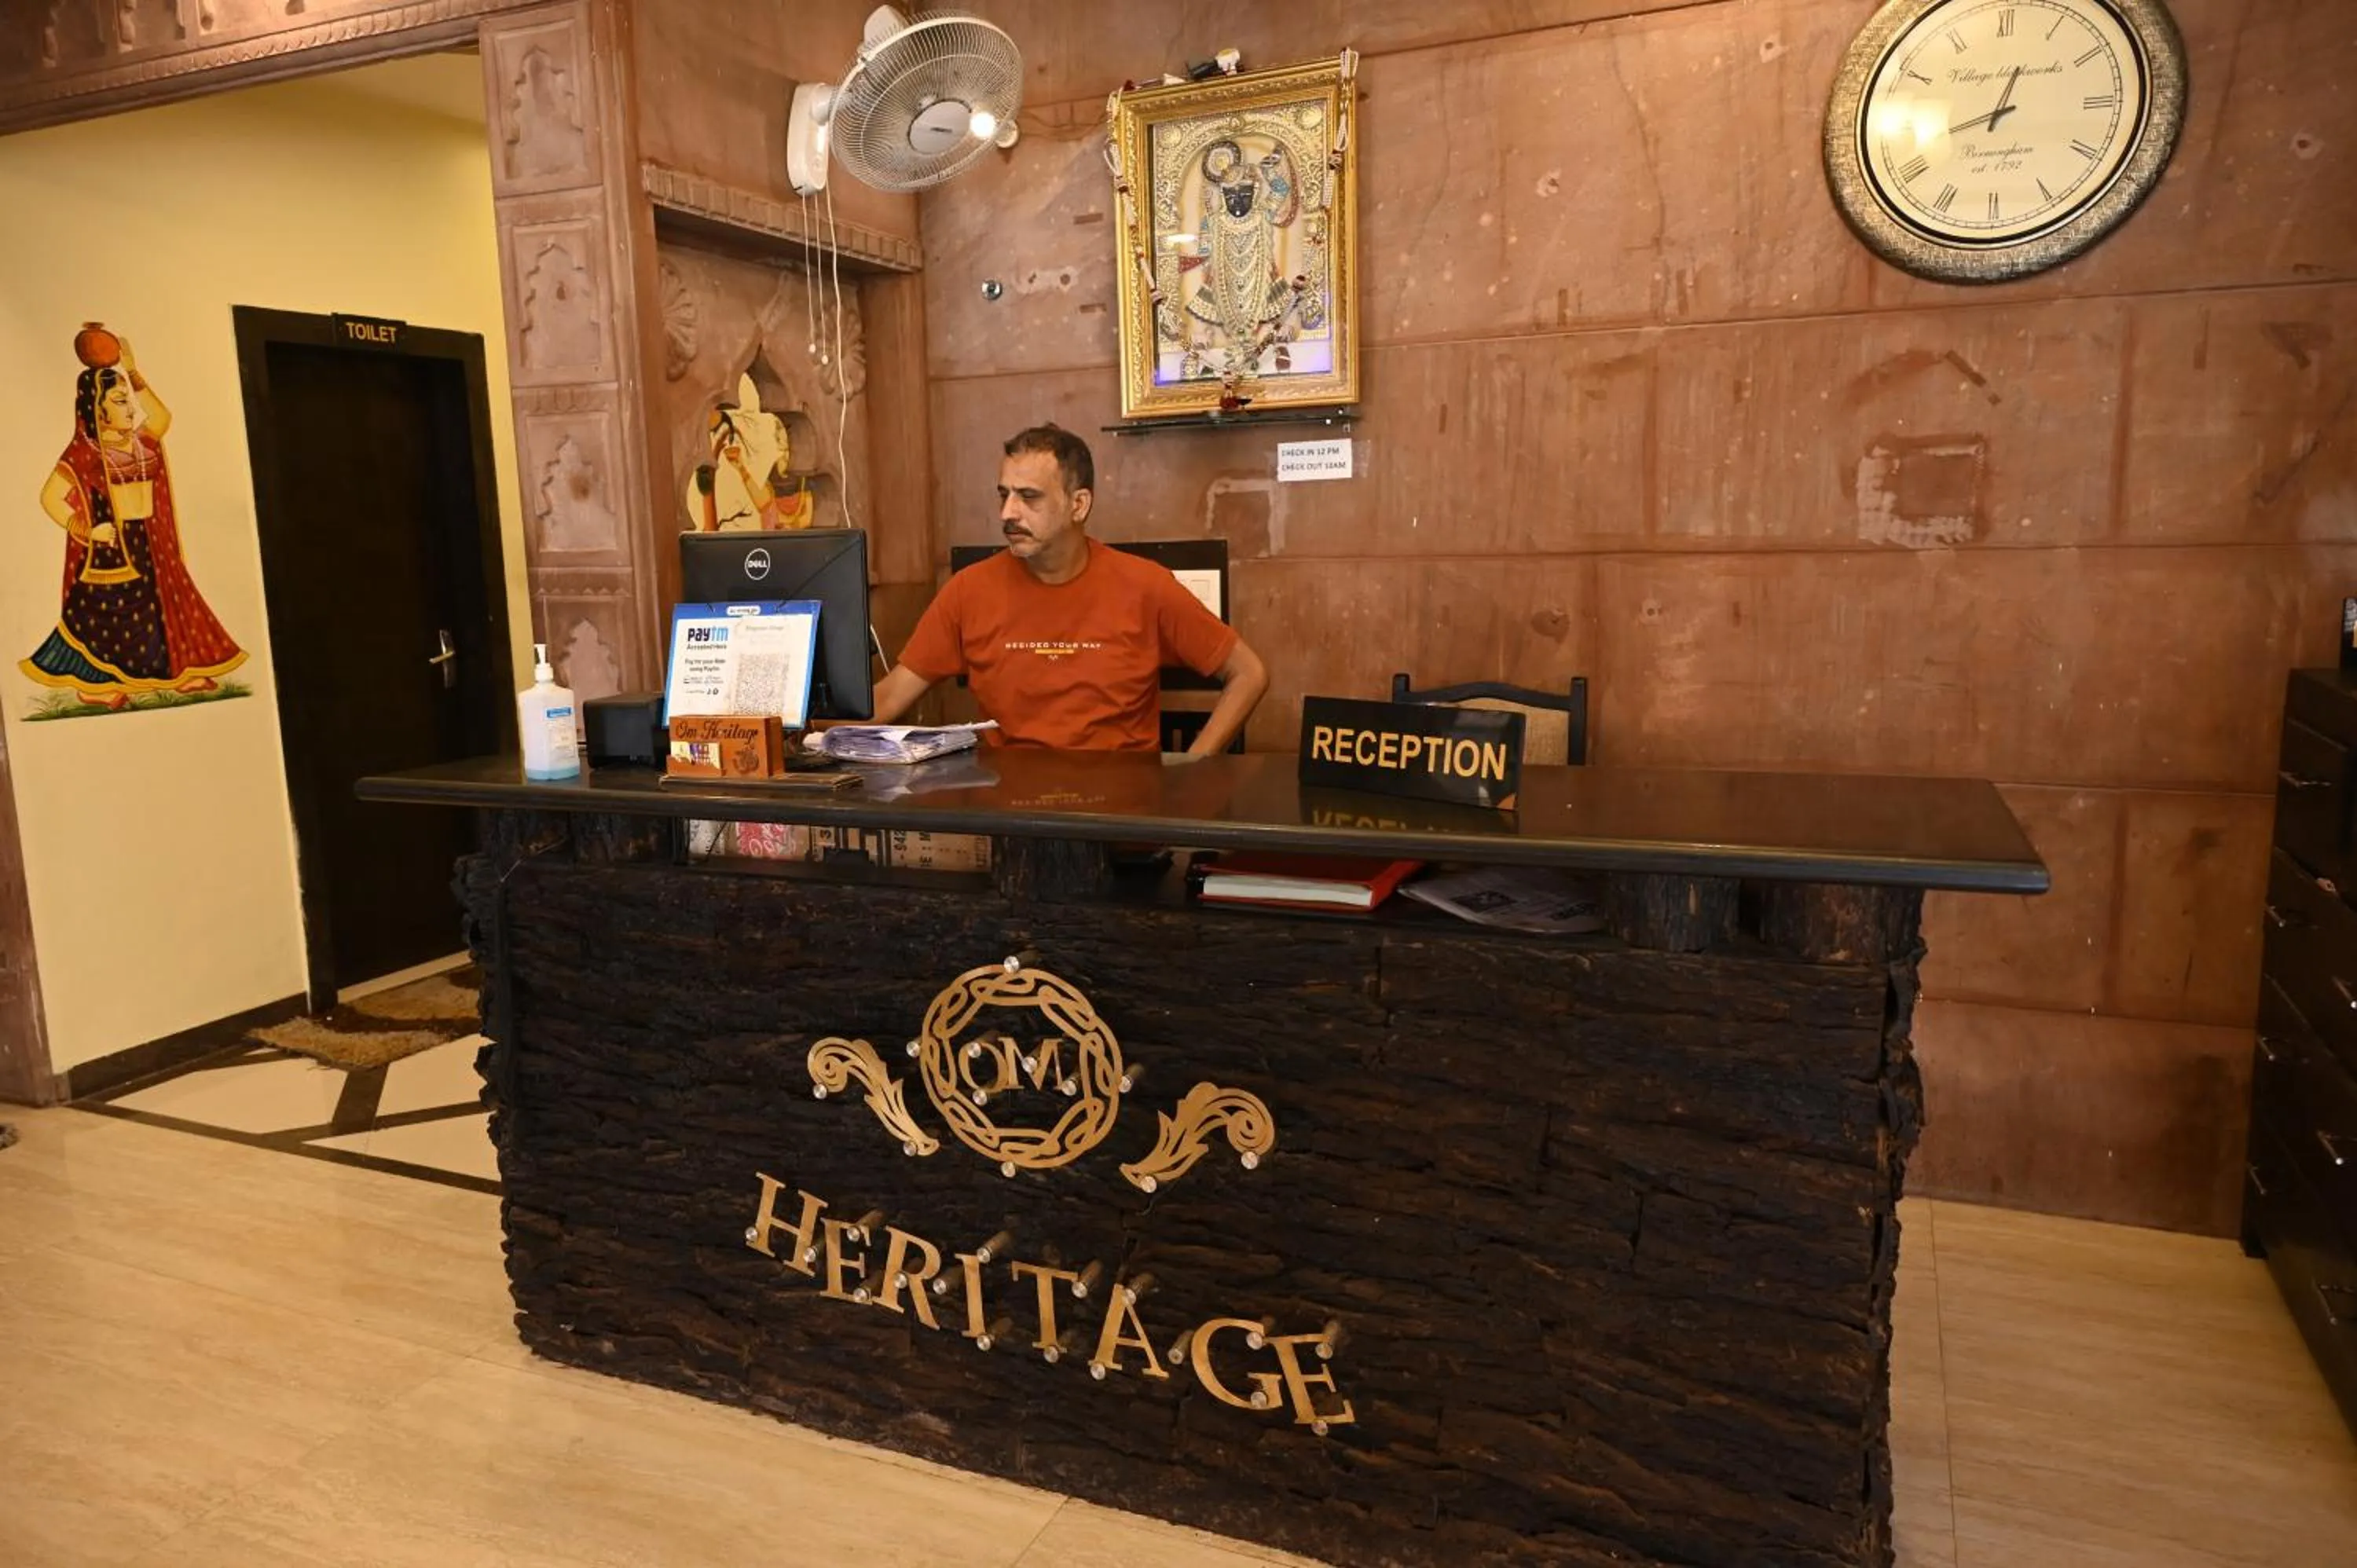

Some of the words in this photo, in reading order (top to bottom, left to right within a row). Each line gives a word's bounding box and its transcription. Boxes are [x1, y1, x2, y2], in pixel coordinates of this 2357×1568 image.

[346, 322, 396, 343] TOILET
[676, 721, 697, 739] Om
[1311, 725, 1506, 781] RECEPTION
[959, 1036, 1064, 1094] OM
[745, 1171, 1354, 1426] HERITAGE
